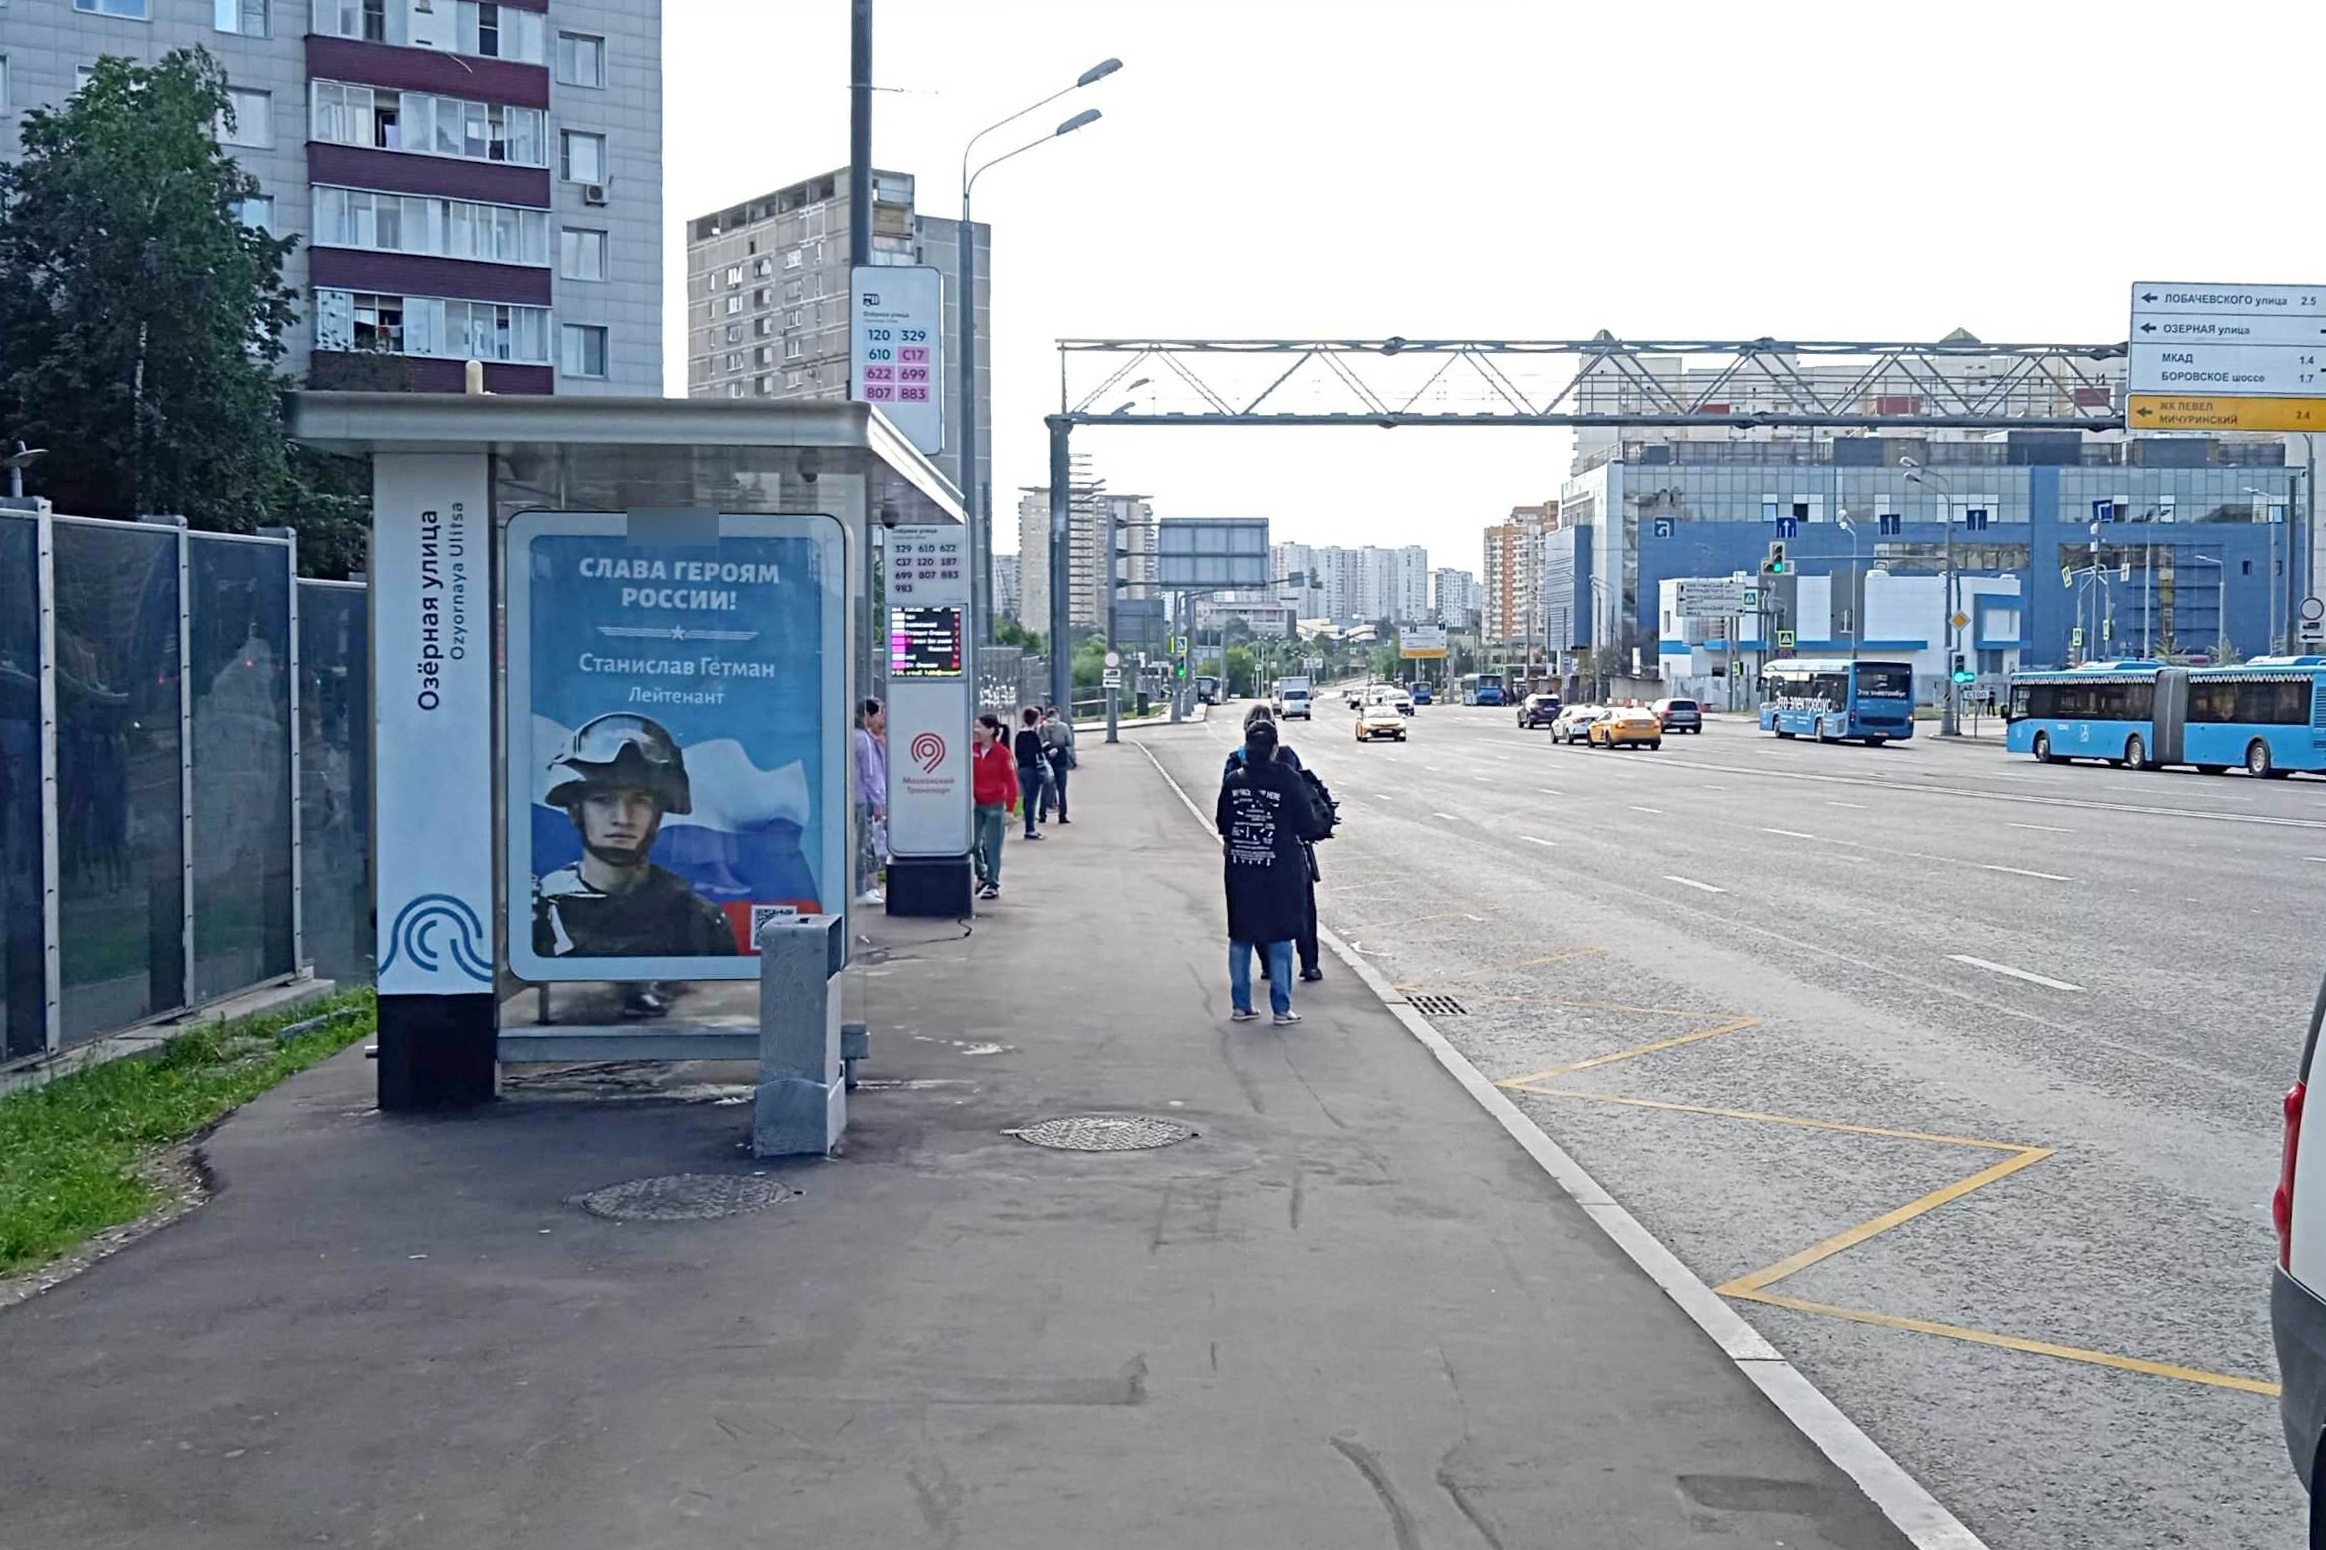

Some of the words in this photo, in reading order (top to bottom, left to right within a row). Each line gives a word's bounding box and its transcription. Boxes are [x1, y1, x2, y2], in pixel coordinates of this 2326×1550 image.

[2164, 293, 2253, 305] ЛОБАЧЕВСКОГО
[2255, 296, 2288, 307] улица
[2301, 296, 2317, 306] 2.5
[868, 329, 891, 341] 120
[901, 330, 926, 342] 329
[2163, 324, 2216, 334] ОЗЕРНАЯ
[2218, 326, 2250, 336] улица
[868, 349, 891, 361] 610
[2162, 353, 2193, 364] МКАД
[2299, 356, 2314, 365] 1.4
[867, 368, 892, 380] 622
[901, 369, 926, 380] 699
[2161, 371, 2229, 382] БОРОВСКОЕ
[2232, 374, 2265, 383] шоссе
[2299, 374, 2314, 383] 1.7
[867, 388, 892, 399] 807
[901, 388, 926, 400] 883
[2178, 402, 2213, 411] ЛЕВЕЛ
[2159, 415, 2238, 425] МИЧУРИНСКИЙ
[449, 502, 464, 557] Ulitsa
[421, 511, 444, 590] улица
[895, 545, 912, 553] 329
[918, 545, 935, 553] 610
[917, 558, 934, 566] 120
[579, 557, 667, 580] СЛАВА
[674, 561, 780, 585] ГЕРОЯМ
[895, 572, 913, 580] 699
[621, 587, 737, 611] РОССИИ!
[450, 563, 468, 660] Ozyornaya
[417, 597, 444, 711] Озёрная
[579, 653, 695, 676] Станислав
[628, 686, 725, 705] Лейтенант
